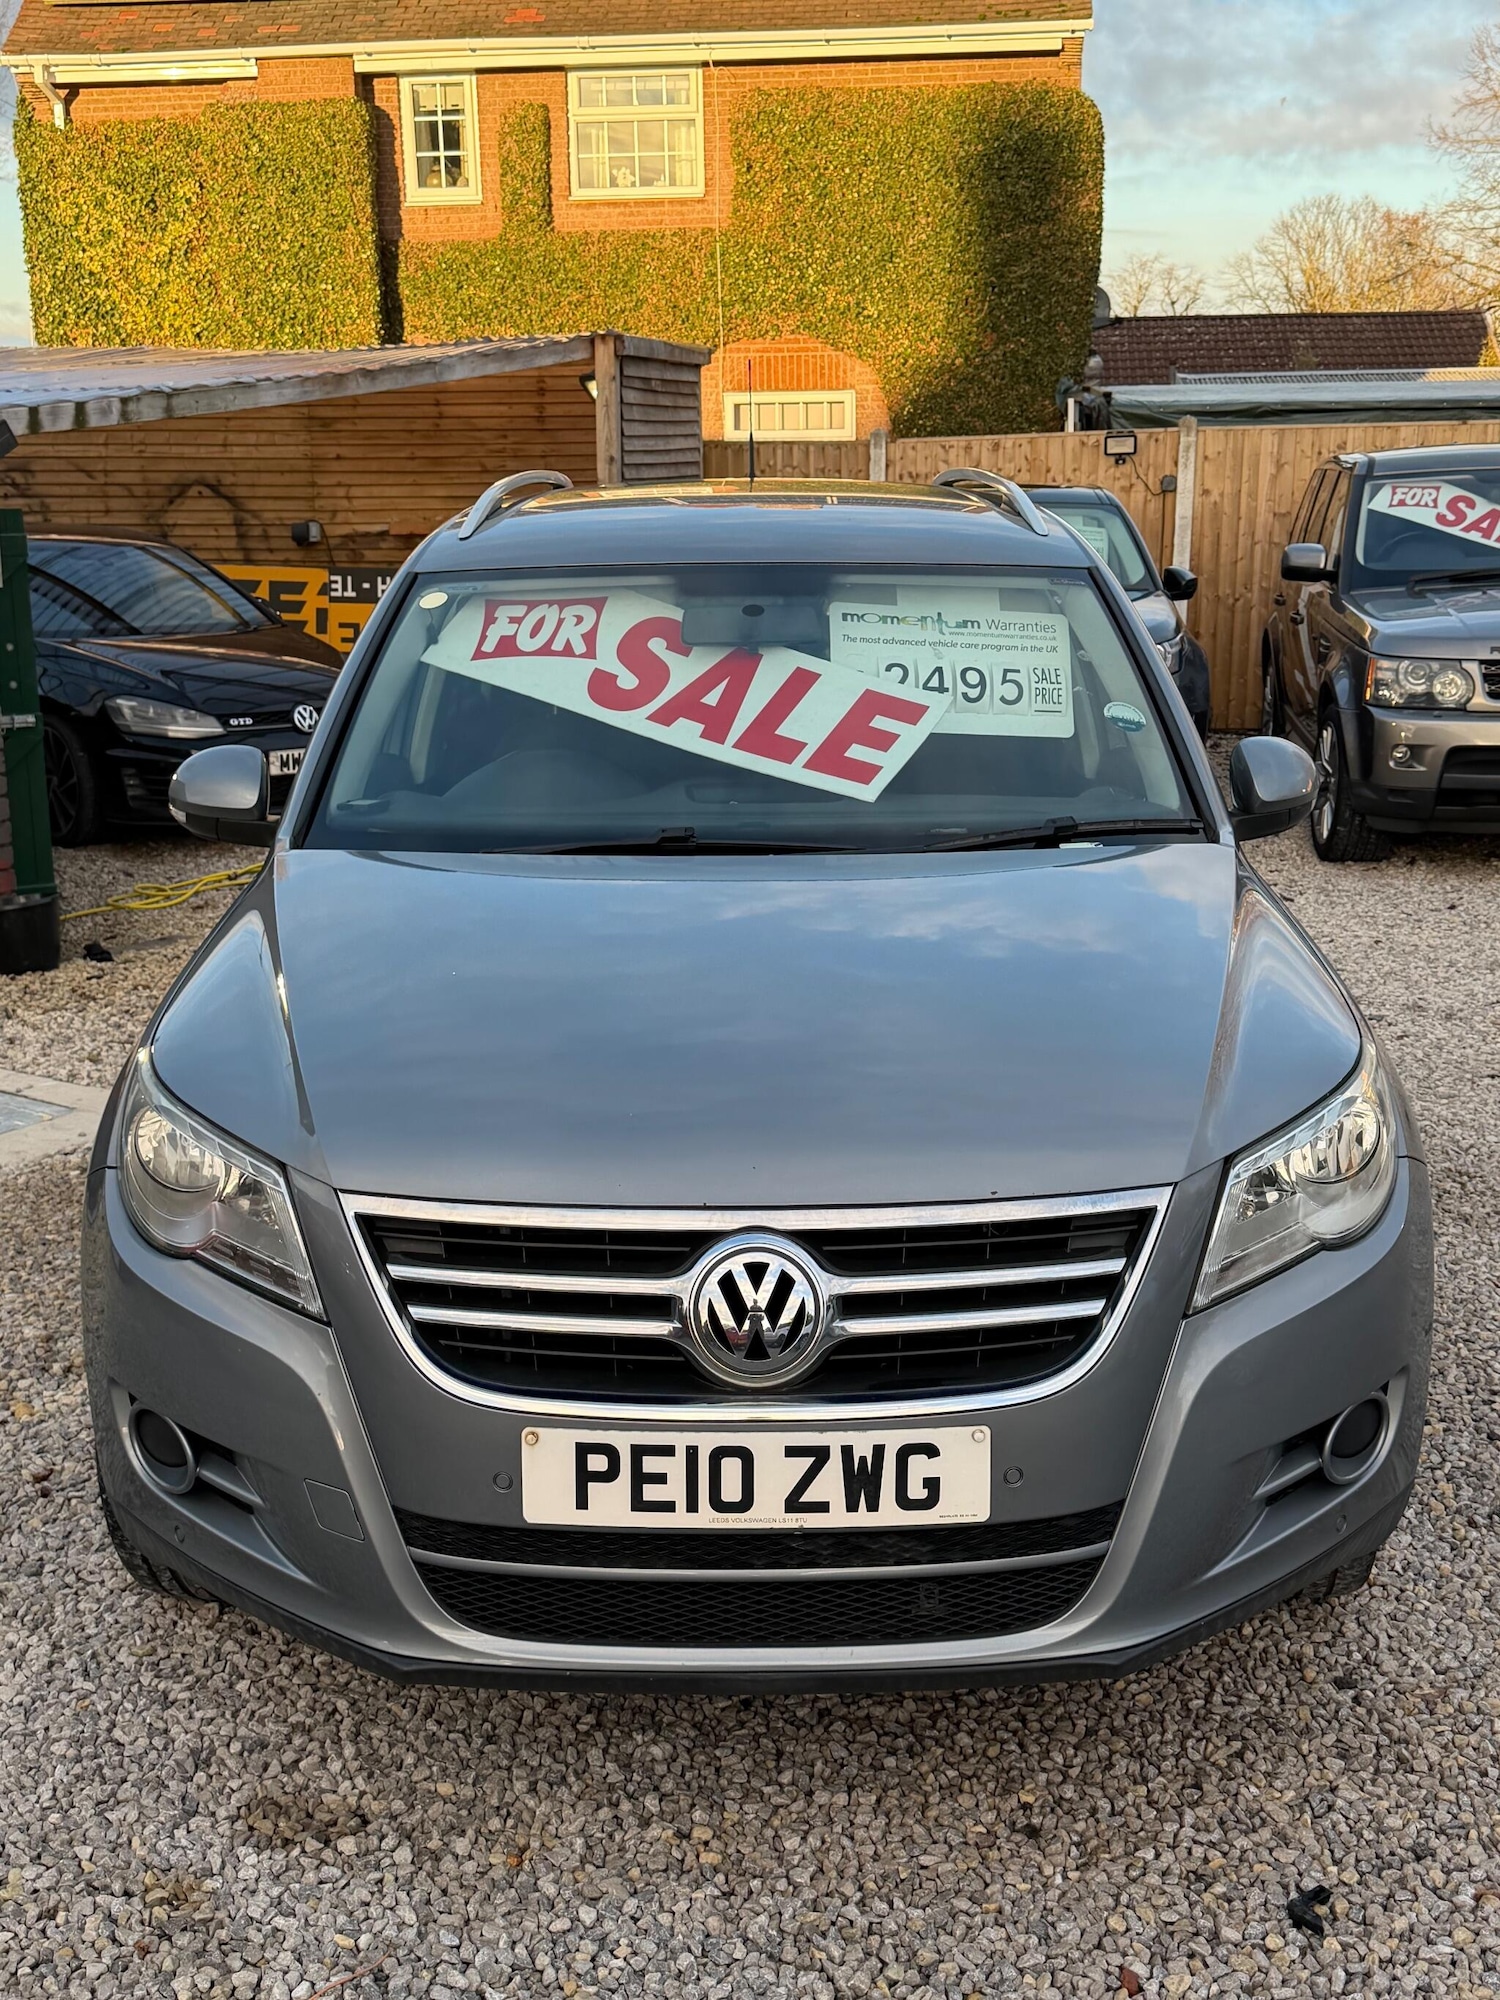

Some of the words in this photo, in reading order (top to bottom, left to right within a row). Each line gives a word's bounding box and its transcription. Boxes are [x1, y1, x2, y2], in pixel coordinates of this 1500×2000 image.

[1391, 487, 1438, 507] FOR
[1435, 494, 1500, 544] SA
[841, 612, 981, 635] momentum
[985, 618, 1057, 634] Warranties
[842, 634, 858, 643] The
[859, 636, 881, 644] most
[882, 637, 927, 647] advanced
[928, 639, 958, 648] vehicle
[959, 641, 980, 650] care
[980, 642, 1019, 652] program
[1020, 643, 1029, 652] in
[1030, 643, 1044, 652] the
[1045, 645, 1059, 653] UK
[948, 630, 1057, 641] www.momentumwarranties.co.uk
[1033, 667, 1063, 685] SALE
[481, 603, 597, 656] FOR
[587, 616, 930, 786] SALE
[1034, 687, 1063, 705] PRICE
[229, 717, 254, 726] GTD
[575, 1441, 755, 1514] PE10
[783, 1442, 941, 1514] ZWG
